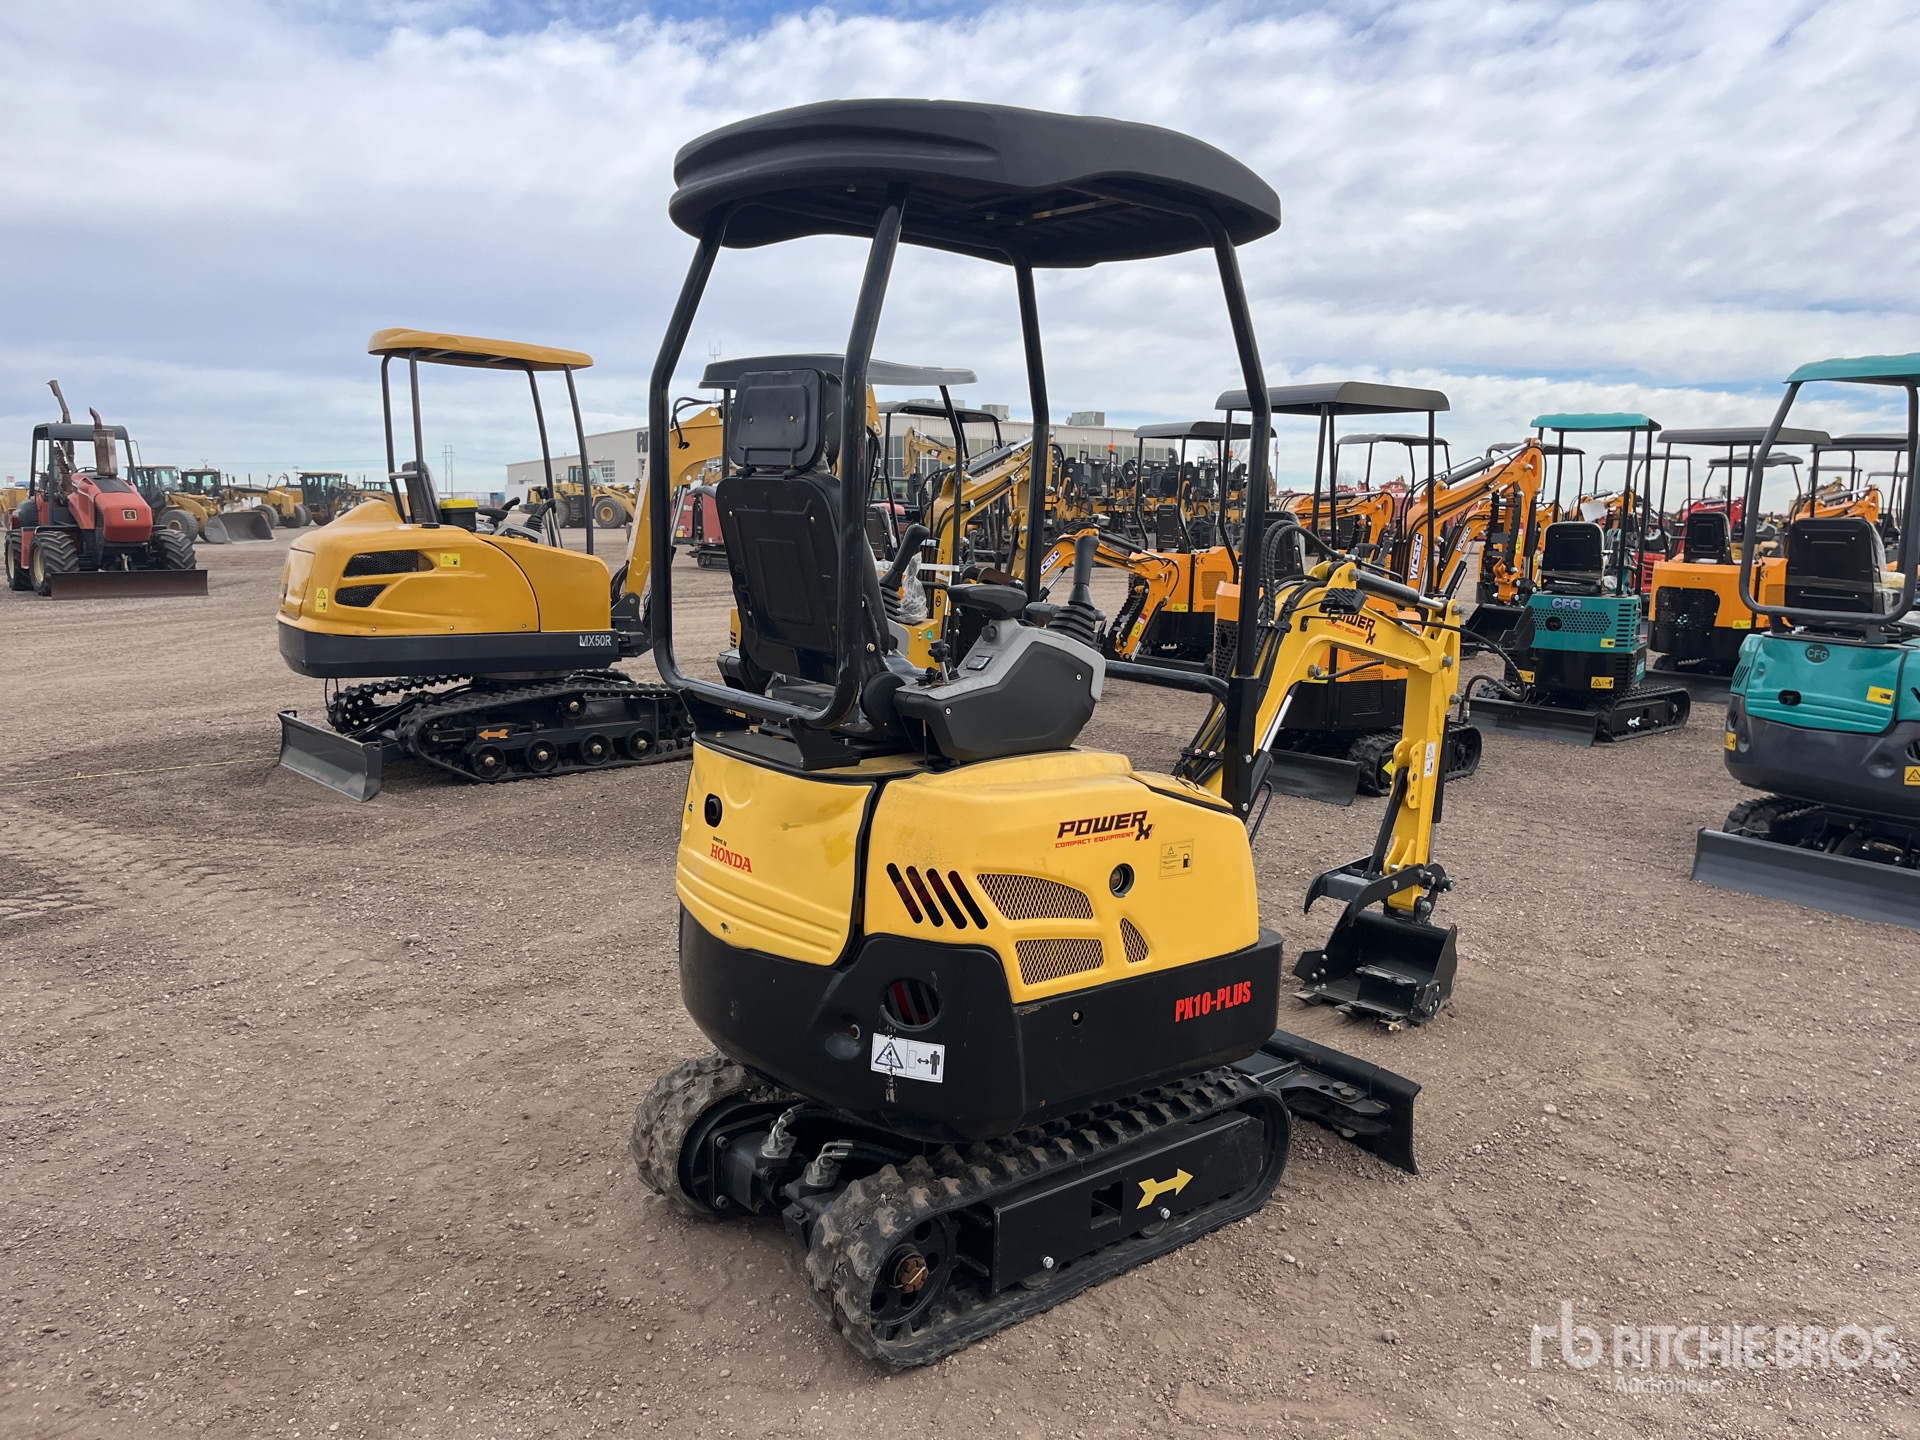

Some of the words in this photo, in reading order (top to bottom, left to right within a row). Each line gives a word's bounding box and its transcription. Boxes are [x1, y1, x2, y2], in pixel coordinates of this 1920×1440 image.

[1409, 533, 1424, 579] VICSEC
[1551, 598, 1582, 610] CFG
[579, 634, 612, 647] MX50R
[1806, 648, 1829, 660] CFG
[1057, 810, 1148, 839] POWER
[1055, 838, 1091, 849] COMPACT
[1094, 831, 1135, 843] EQUIPMENT
[710, 843, 752, 873] HONDA
[1175, 981, 1251, 1022] PX10-PLUS
